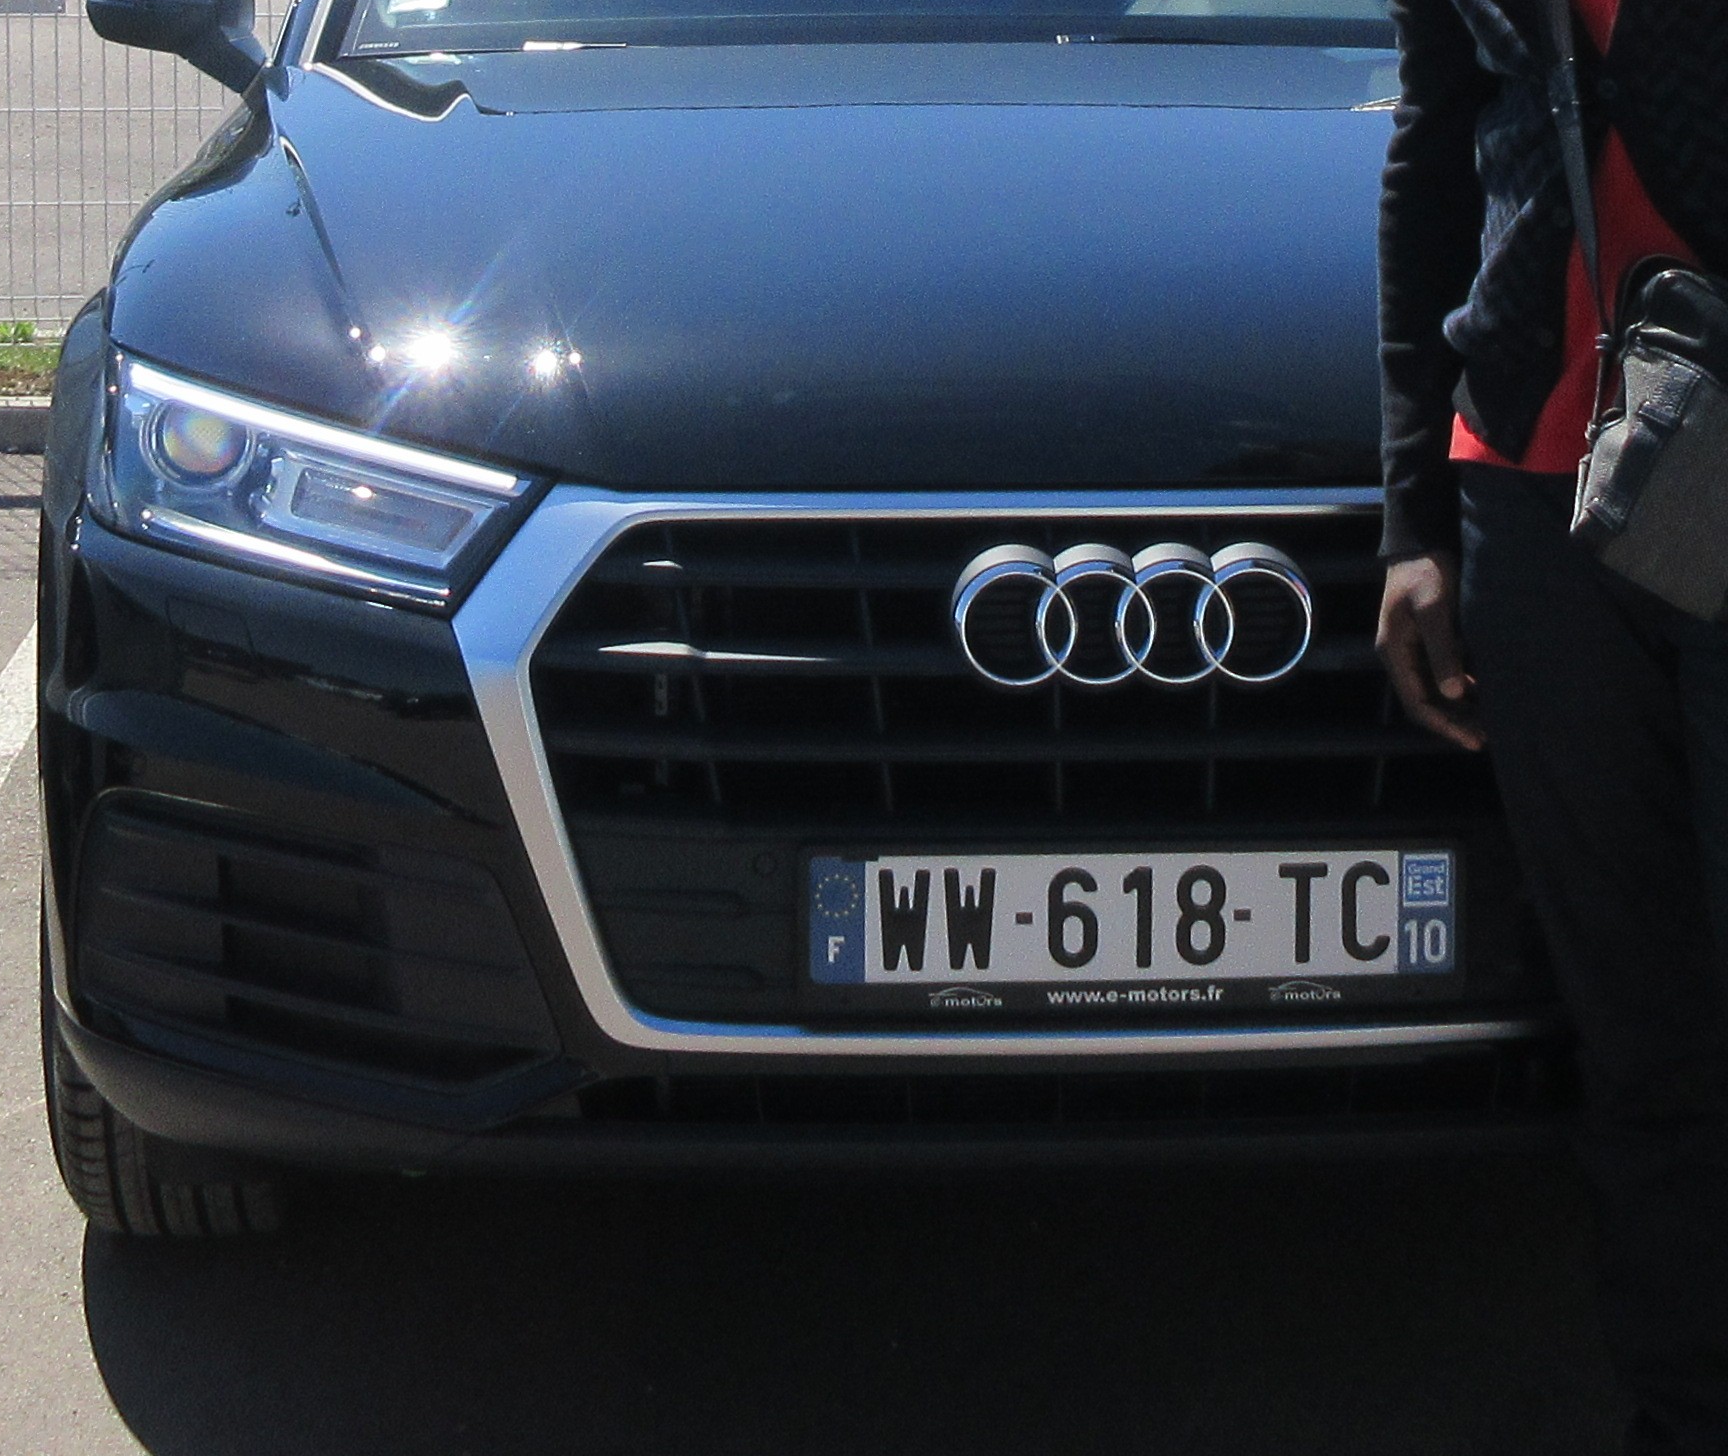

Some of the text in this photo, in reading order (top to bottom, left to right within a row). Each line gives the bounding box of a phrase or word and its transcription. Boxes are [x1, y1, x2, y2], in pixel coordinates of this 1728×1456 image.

[1408, 875, 1446, 896] Est
[878, 860, 1391, 972] WW-618-TC
[826, 937, 845, 964] F
[1404, 918, 1447, 964] 10
[1047, 985, 1225, 1006] www.e-motors.fr
